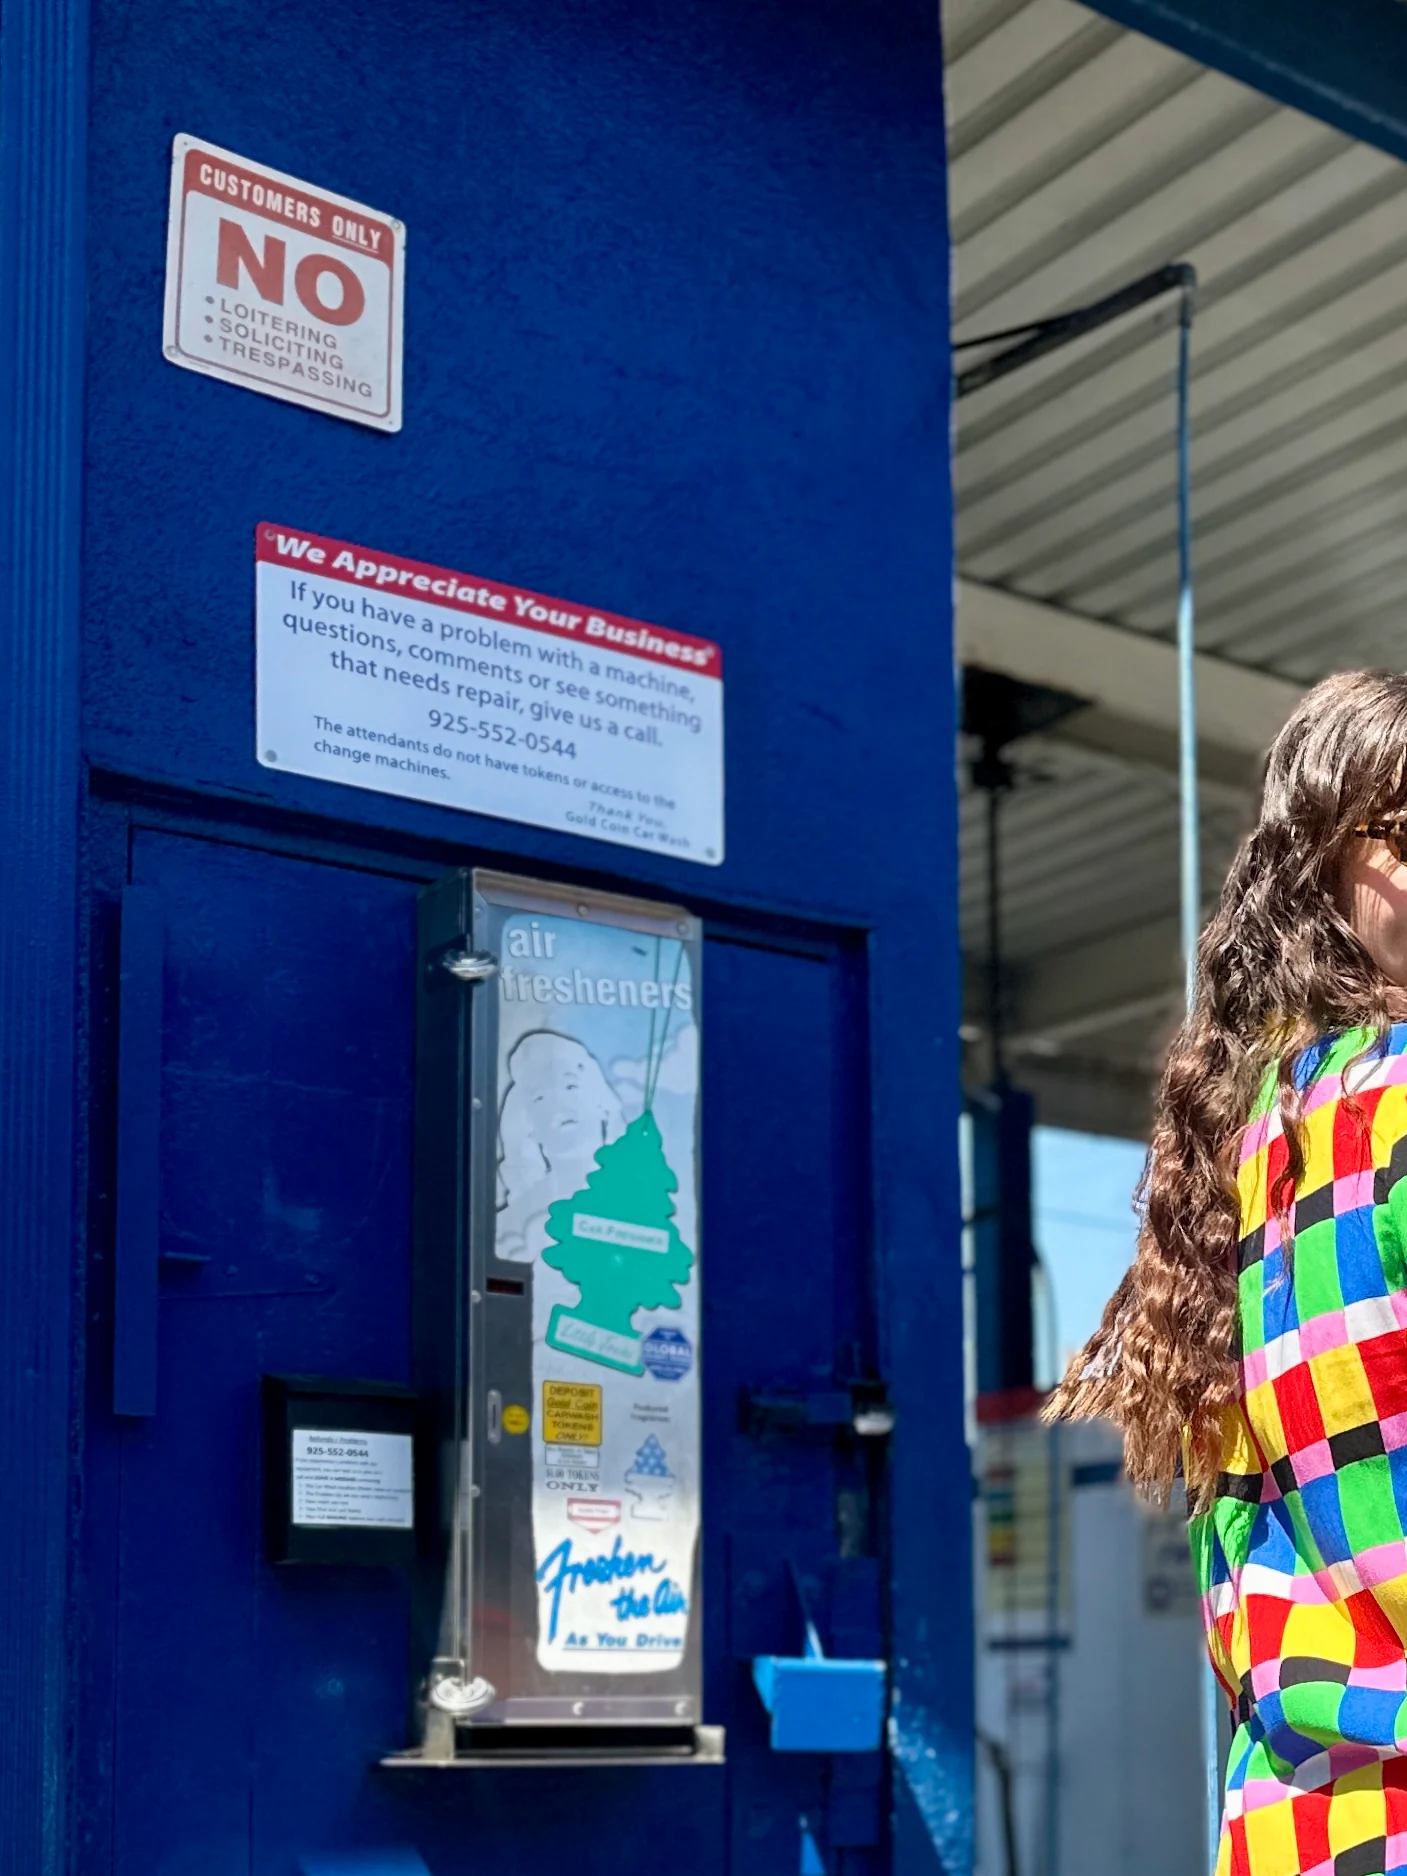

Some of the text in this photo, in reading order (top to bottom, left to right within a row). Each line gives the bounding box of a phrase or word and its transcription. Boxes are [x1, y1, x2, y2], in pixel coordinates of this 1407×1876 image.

[200, 163, 383, 250] CUSTOMERS ONLY
[216, 217, 366, 326] NO
[219, 318, 344, 370] SOLICITING
[220, 298, 337, 349] LOITERING
[219, 336, 373, 398] TRESPASSING
[277, 534, 709, 666] We Appreciate Your Business
[290, 581, 696, 704] If you have a problem with a machine,
[283, 613, 703, 734] questions, comments or see something
[330, 650, 663, 748] that needs repair, give us a call.
[314, 739, 451, 780] change machines.
[428, 709, 577, 760] 925-552-0544
[314, 715, 676, 810] The attendants do not have tokens or access to the
[565, 810, 690, 849] Gold Coin Car Wash
[507, 921, 557, 959] air
[500, 965, 692, 1011] fresheners
[546, 1410, 598, 1422] CARWASH
[549, 1386, 596, 1398] DEPOSIT
[551, 1420, 594, 1432] TOKENS
[306, 1446, 369, 1458] 925-552-0544
[546, 1480, 599, 1492] ONLY
[565, 1632, 683, 1647] As You Drive
